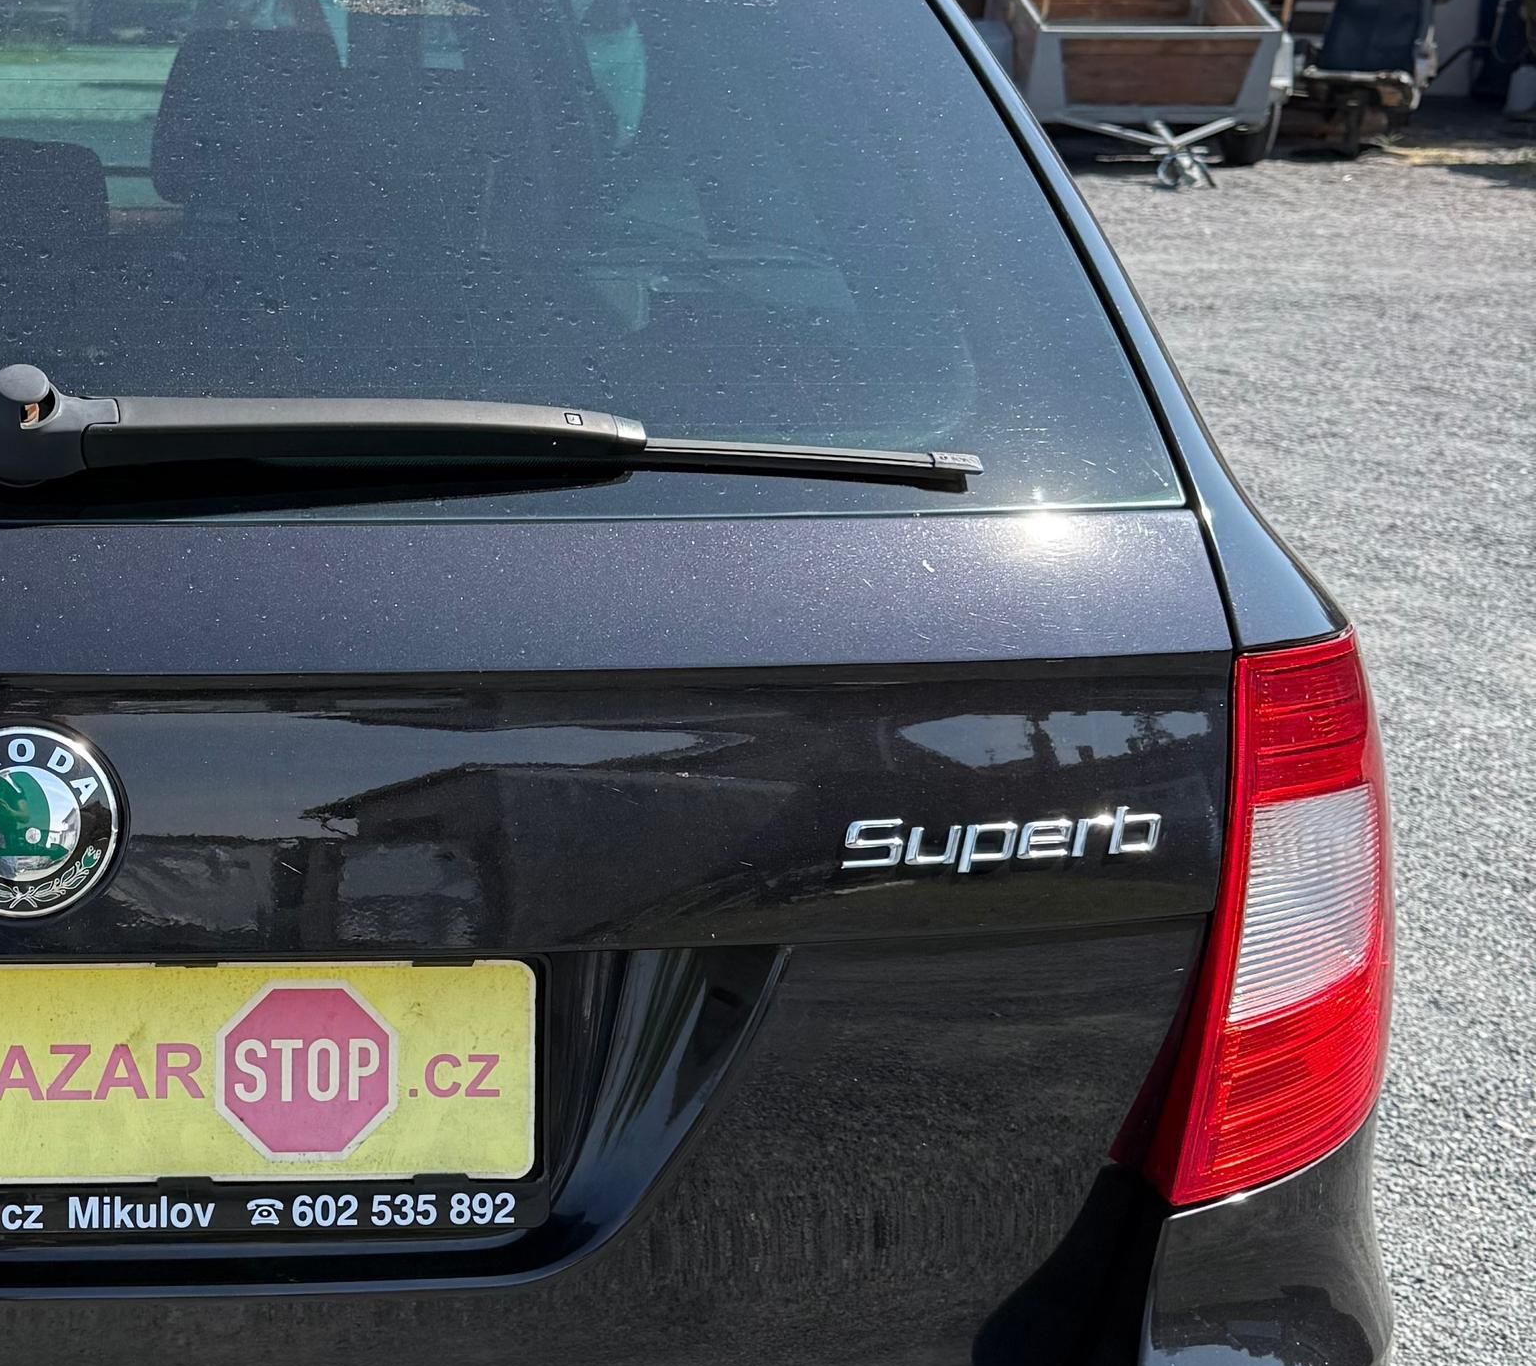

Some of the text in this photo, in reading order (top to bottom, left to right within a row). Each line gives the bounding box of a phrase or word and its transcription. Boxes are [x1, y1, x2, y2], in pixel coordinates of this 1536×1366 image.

[840, 804, 1162, 873] Superb
[67, 1195, 216, 1230] Mikulov
[291, 1193, 358, 1228] 602
[370, 1193, 437, 1227] 535
[448, 1192, 516, 1225] 892
